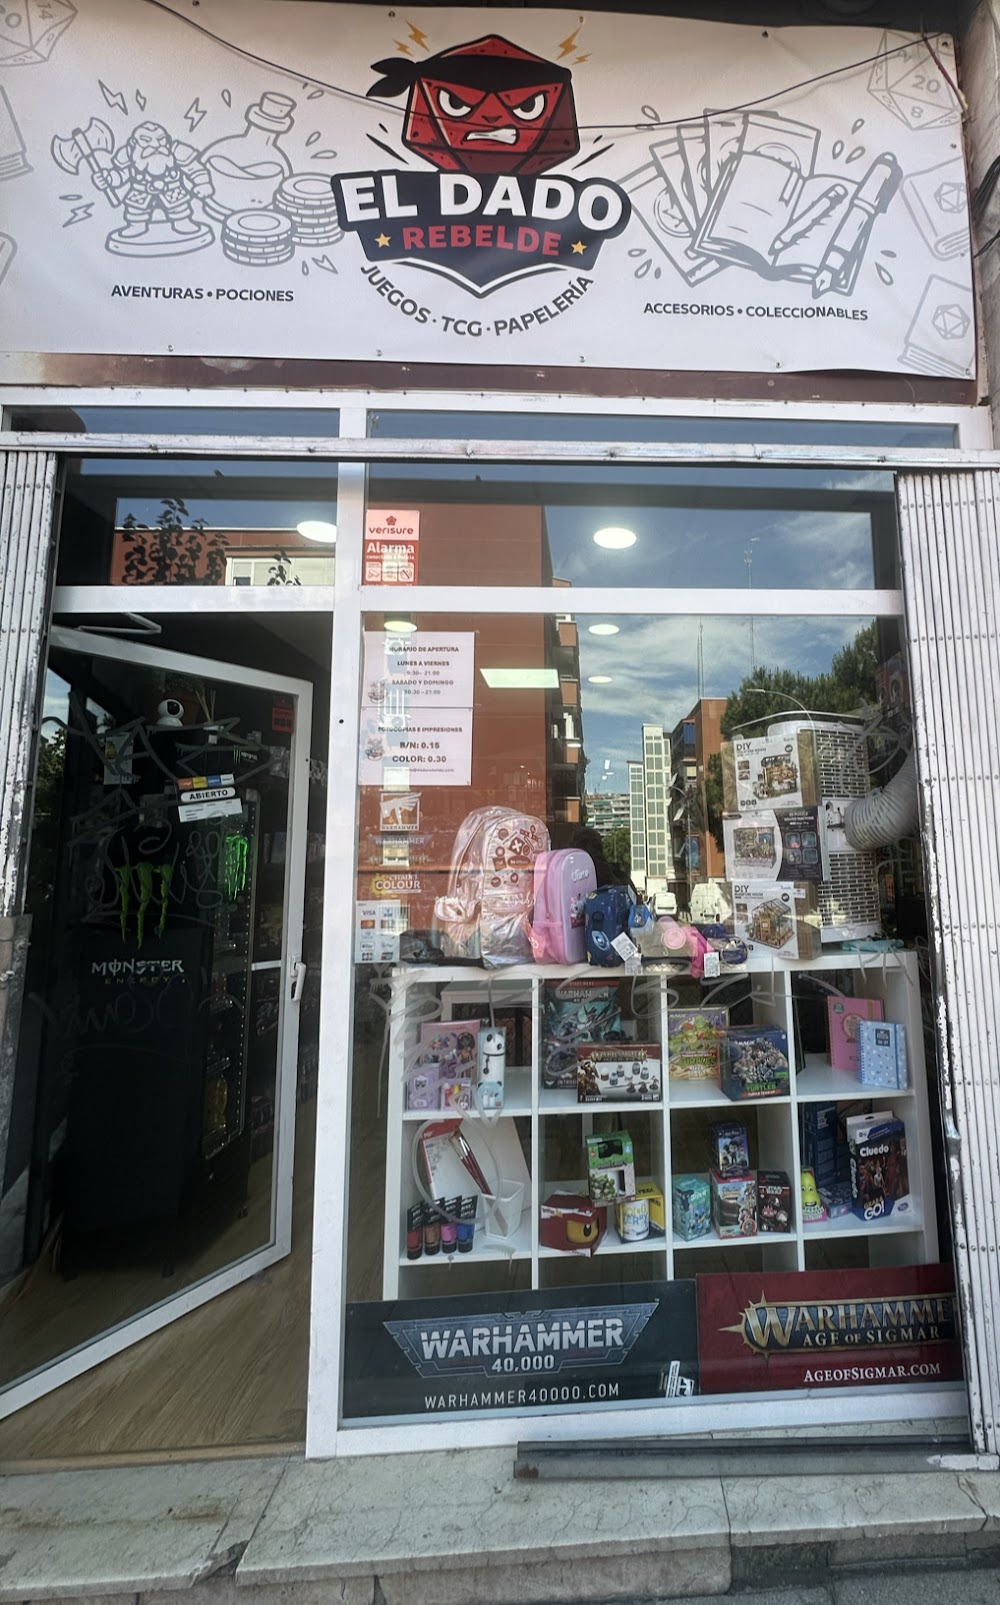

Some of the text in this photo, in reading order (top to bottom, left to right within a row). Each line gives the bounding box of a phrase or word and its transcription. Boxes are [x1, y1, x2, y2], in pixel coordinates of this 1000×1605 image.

[912, 75, 941, 93] 20
[340, 173, 623, 231] EL DADO
[402, 224, 562, 257] REBELDE
[111, 285, 294, 302] AVENTURAS POCIONES
[360, 264, 594, 337] JUEGOS TCG PAPELERÍA
[643, 303, 868, 321] ACCESORIOS COLECCIONABLES
[368, 526, 414, 535] verisure
[367, 541, 415, 553] Alarma
[399, 741, 440, 749] B/N: 0.15
[736, 742, 752, 751] DIY
[392, 755, 447, 763] COLOR: 0.30
[189, 789, 228, 800] ABIERTO
[375, 880, 421, 890] COLOUR
[734, 885, 749, 893] DIY
[91, 958, 185, 976] MONSTER
[859, 1144, 889, 1157] Cluedo
[850, 1157, 859, 1199] Cluedo
[864, 1202, 885, 1221] GO!
[745, 1298, 955, 1348] WARHAMME
[420, 1318, 624, 1360] WARHAMMER
[803, 1325, 940, 1347] AGE OF SIGMAR
[491, 1355, 555, 1374] 40,000
[803, 1363, 941, 1383] AGEOFSIGMAR.COM
[425, 1382, 620, 1409] WARHAMMER40000.COM
